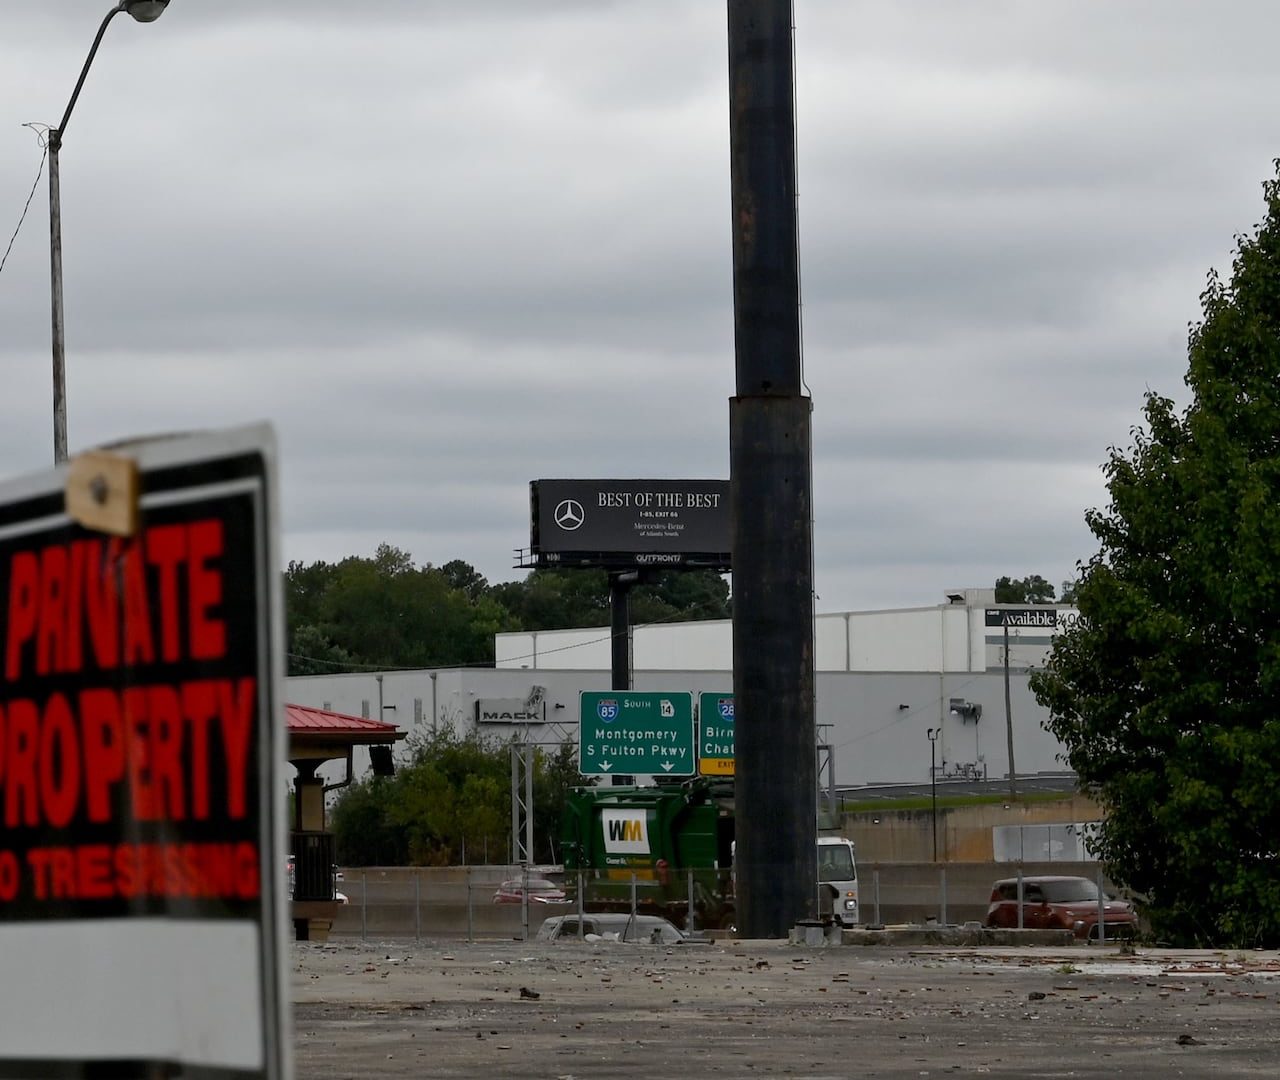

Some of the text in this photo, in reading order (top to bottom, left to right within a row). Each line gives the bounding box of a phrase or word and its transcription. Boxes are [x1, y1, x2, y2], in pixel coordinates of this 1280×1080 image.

[598, 492, 721, 508] BEST OF THE BEST
[6, 520, 226, 682] PRIVATE
[1001, 611, 1054, 626] Available
[483, 711, 540, 720] MACK
[601, 706, 615, 717] 85
[662, 705, 671, 715] 14
[595, 728, 677, 742] Montgomery
[587, 745, 686, 758] S Fulton Pkwy
[609, 820, 643, 841] WM
